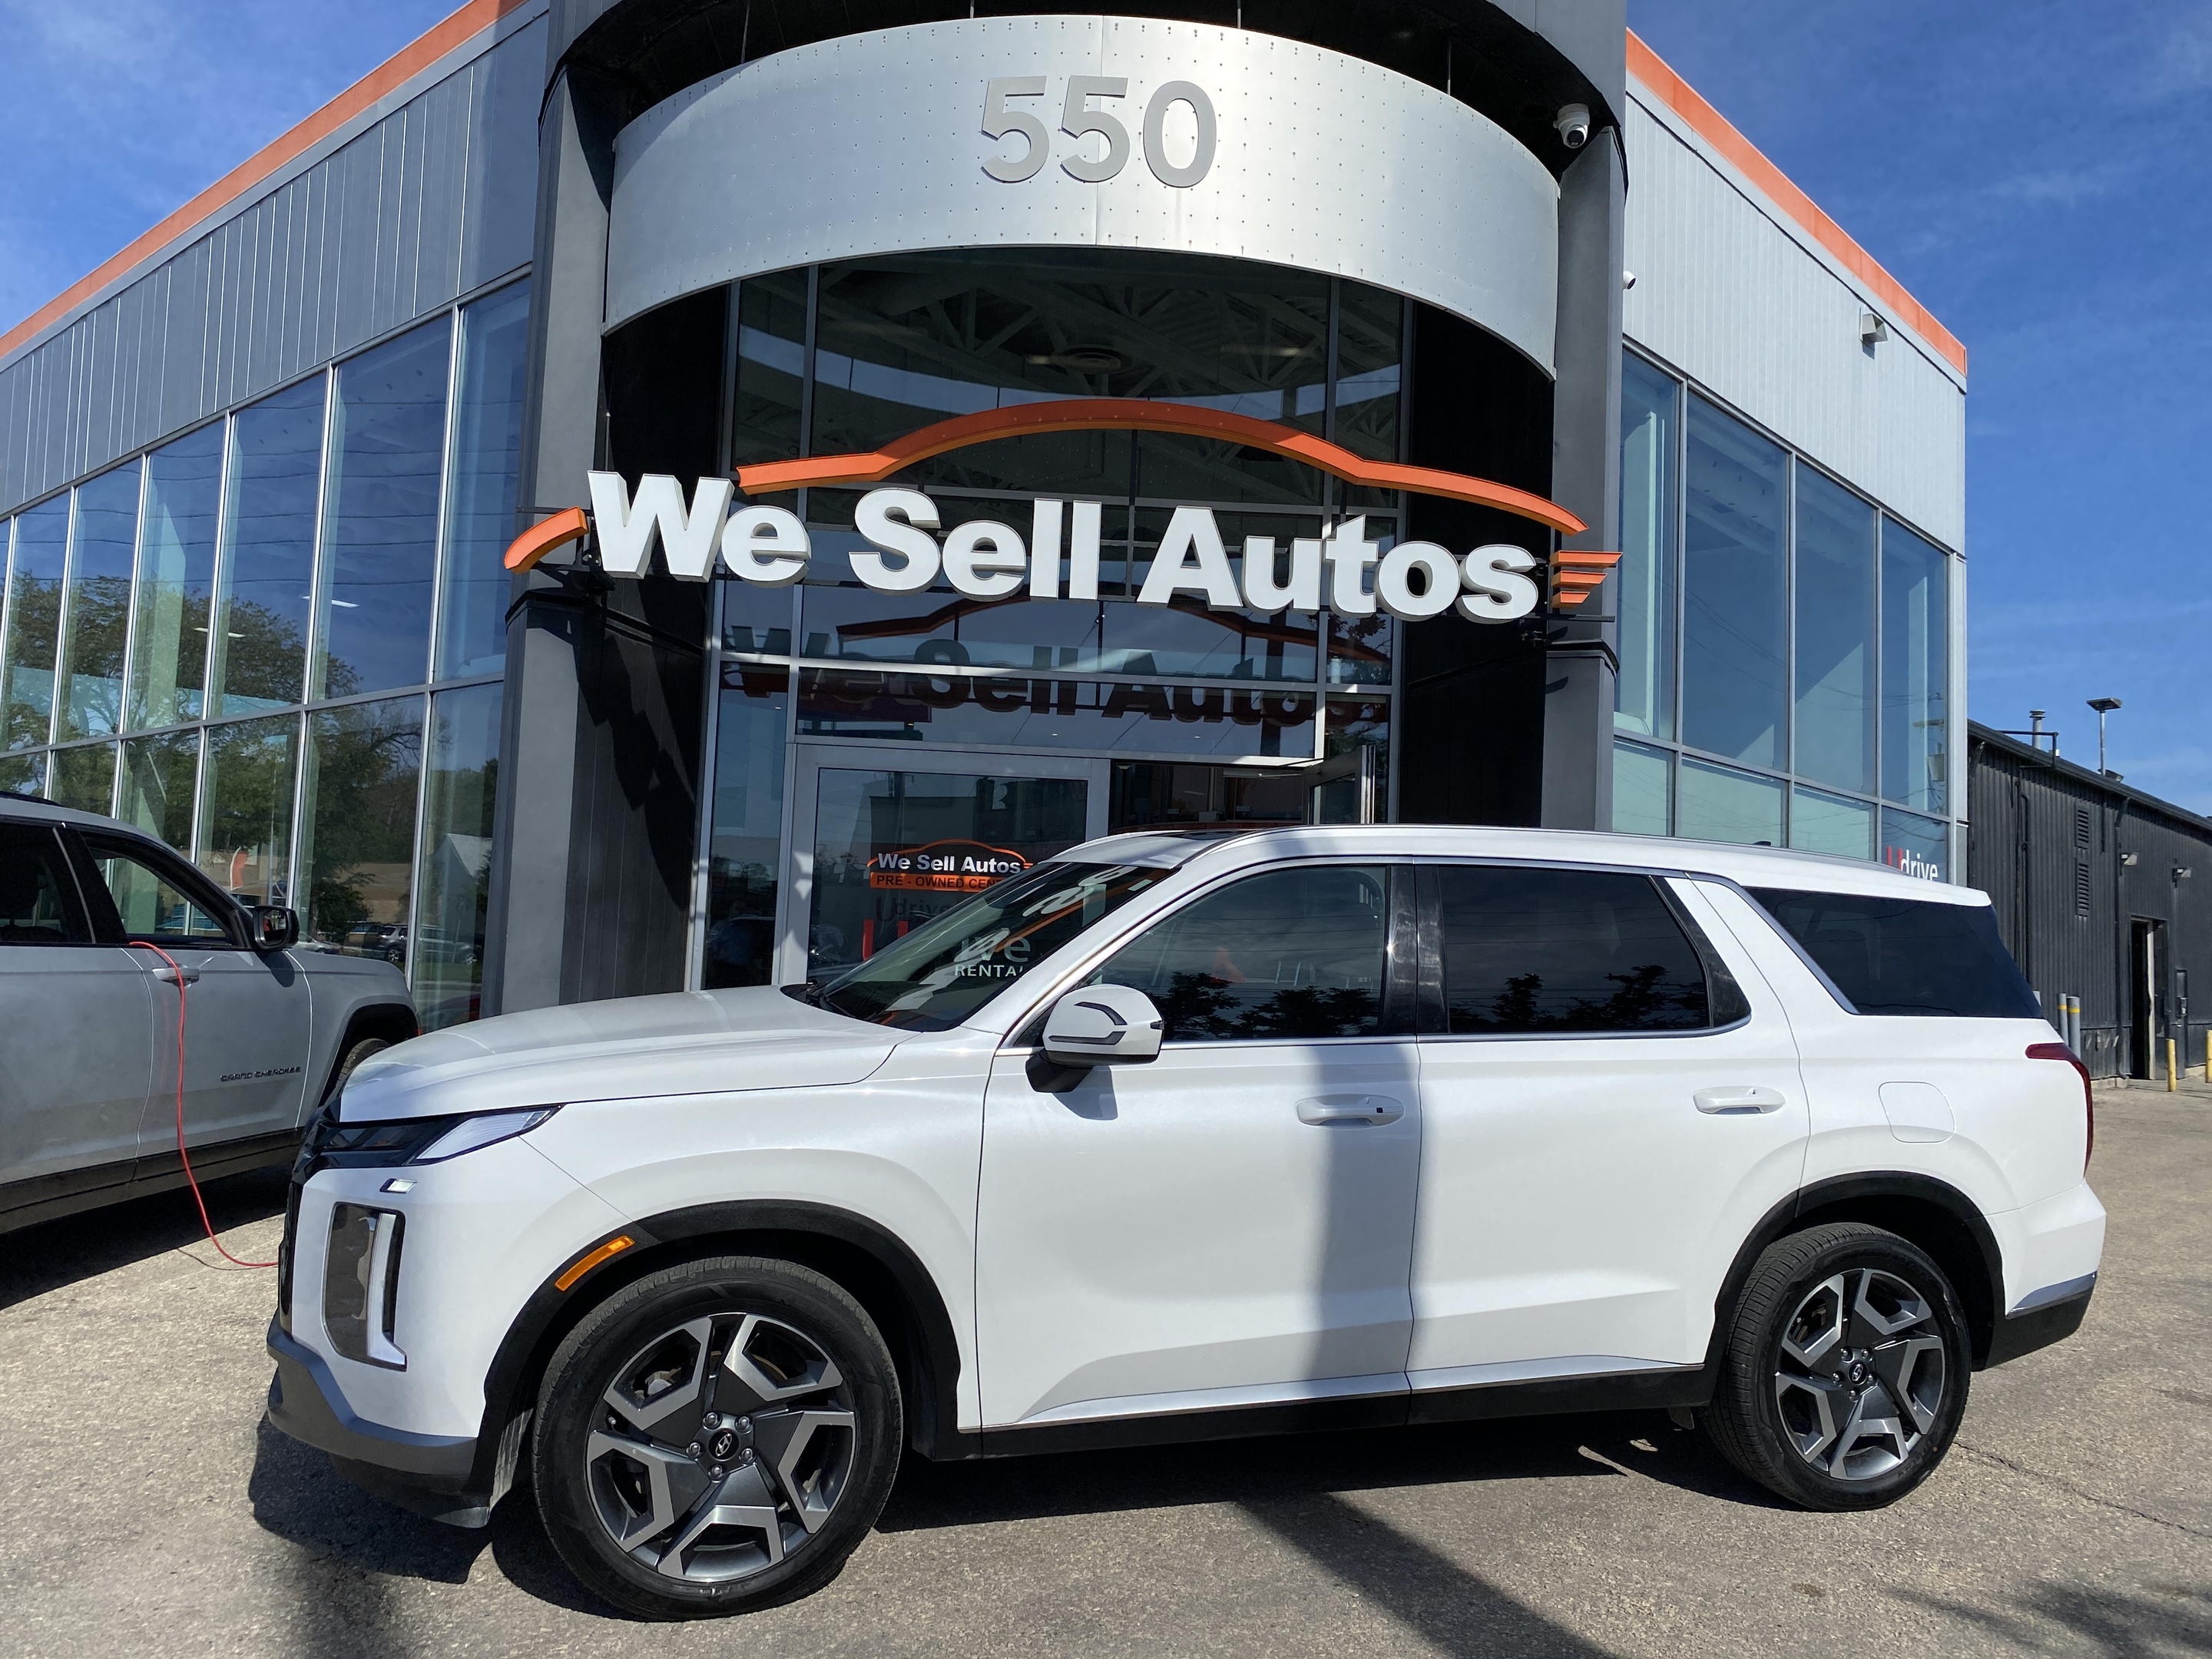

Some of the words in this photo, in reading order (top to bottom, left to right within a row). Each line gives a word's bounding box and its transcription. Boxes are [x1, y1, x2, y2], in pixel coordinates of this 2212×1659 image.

[980, 75, 1217, 189] 550
[587, 469, 813, 588] We
[847, 487, 1103, 602] Sell
[1135, 505, 1539, 624] Autos
[877, 853, 911, 869] We
[916, 854, 955, 872] Sell
[960, 856, 1021, 874] Autos
[876, 875, 903, 886] PRE
[915, 876, 965, 889] OWNED
[969, 878, 1003, 889] CEN
[220, 1071, 253, 1082] GRAND
[254, 1066, 301, 1078] CHEROKEE
